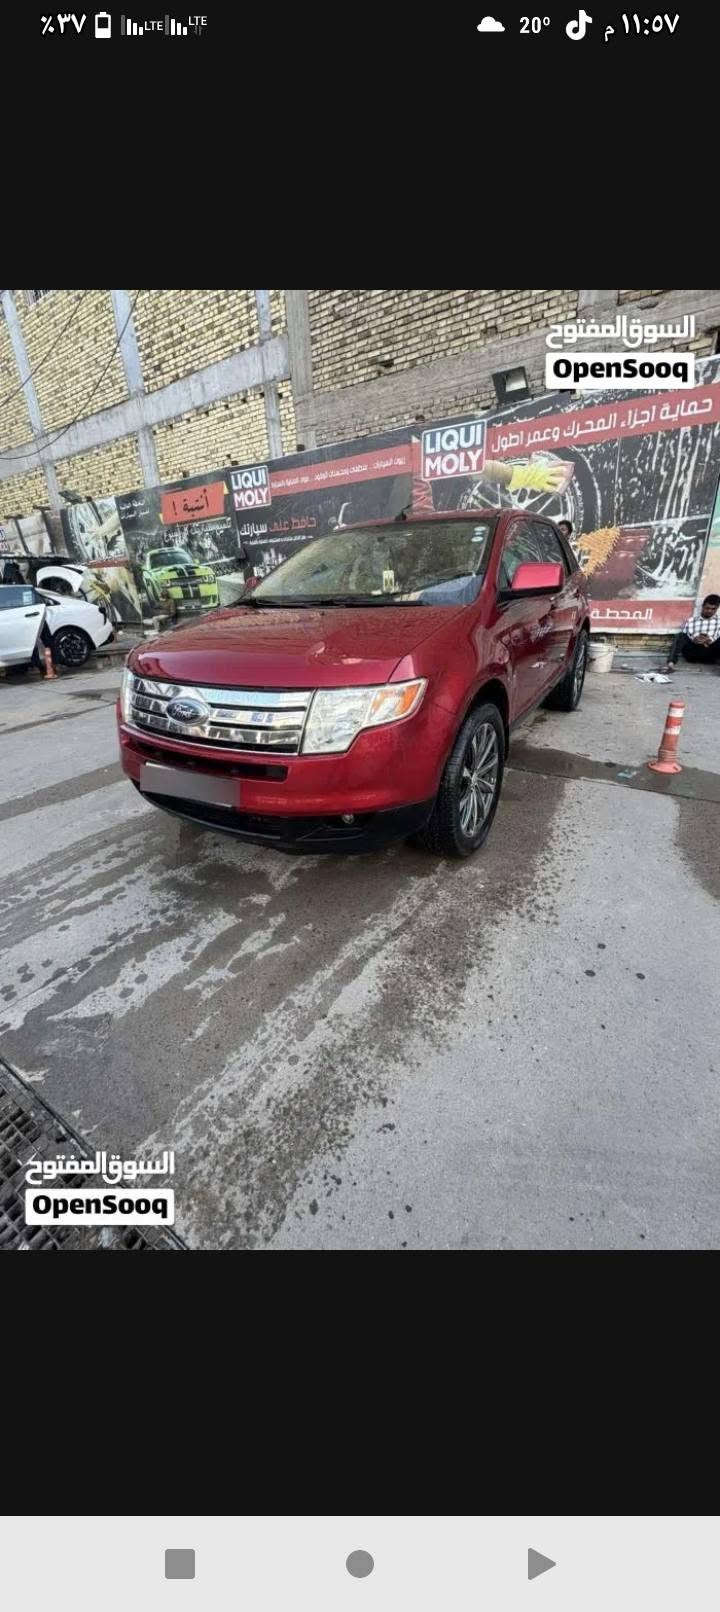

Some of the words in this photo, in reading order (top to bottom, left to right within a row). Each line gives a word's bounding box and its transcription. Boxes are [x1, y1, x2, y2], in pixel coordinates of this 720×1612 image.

[659, 397, 713, 422] حماية
[563, 412, 617, 438] المحرك
[425, 424, 482, 454] LIQUI
[491, 431, 524, 453] اطول
[525, 426, 560, 448] وعمر
[425, 448, 482, 477] MOLY
[231, 468, 266, 490] LIQUI
[233, 487, 268, 507] MOLY
[239, 523, 268, 537] سيارتك
[590, 607, 653, 620] المحطة
